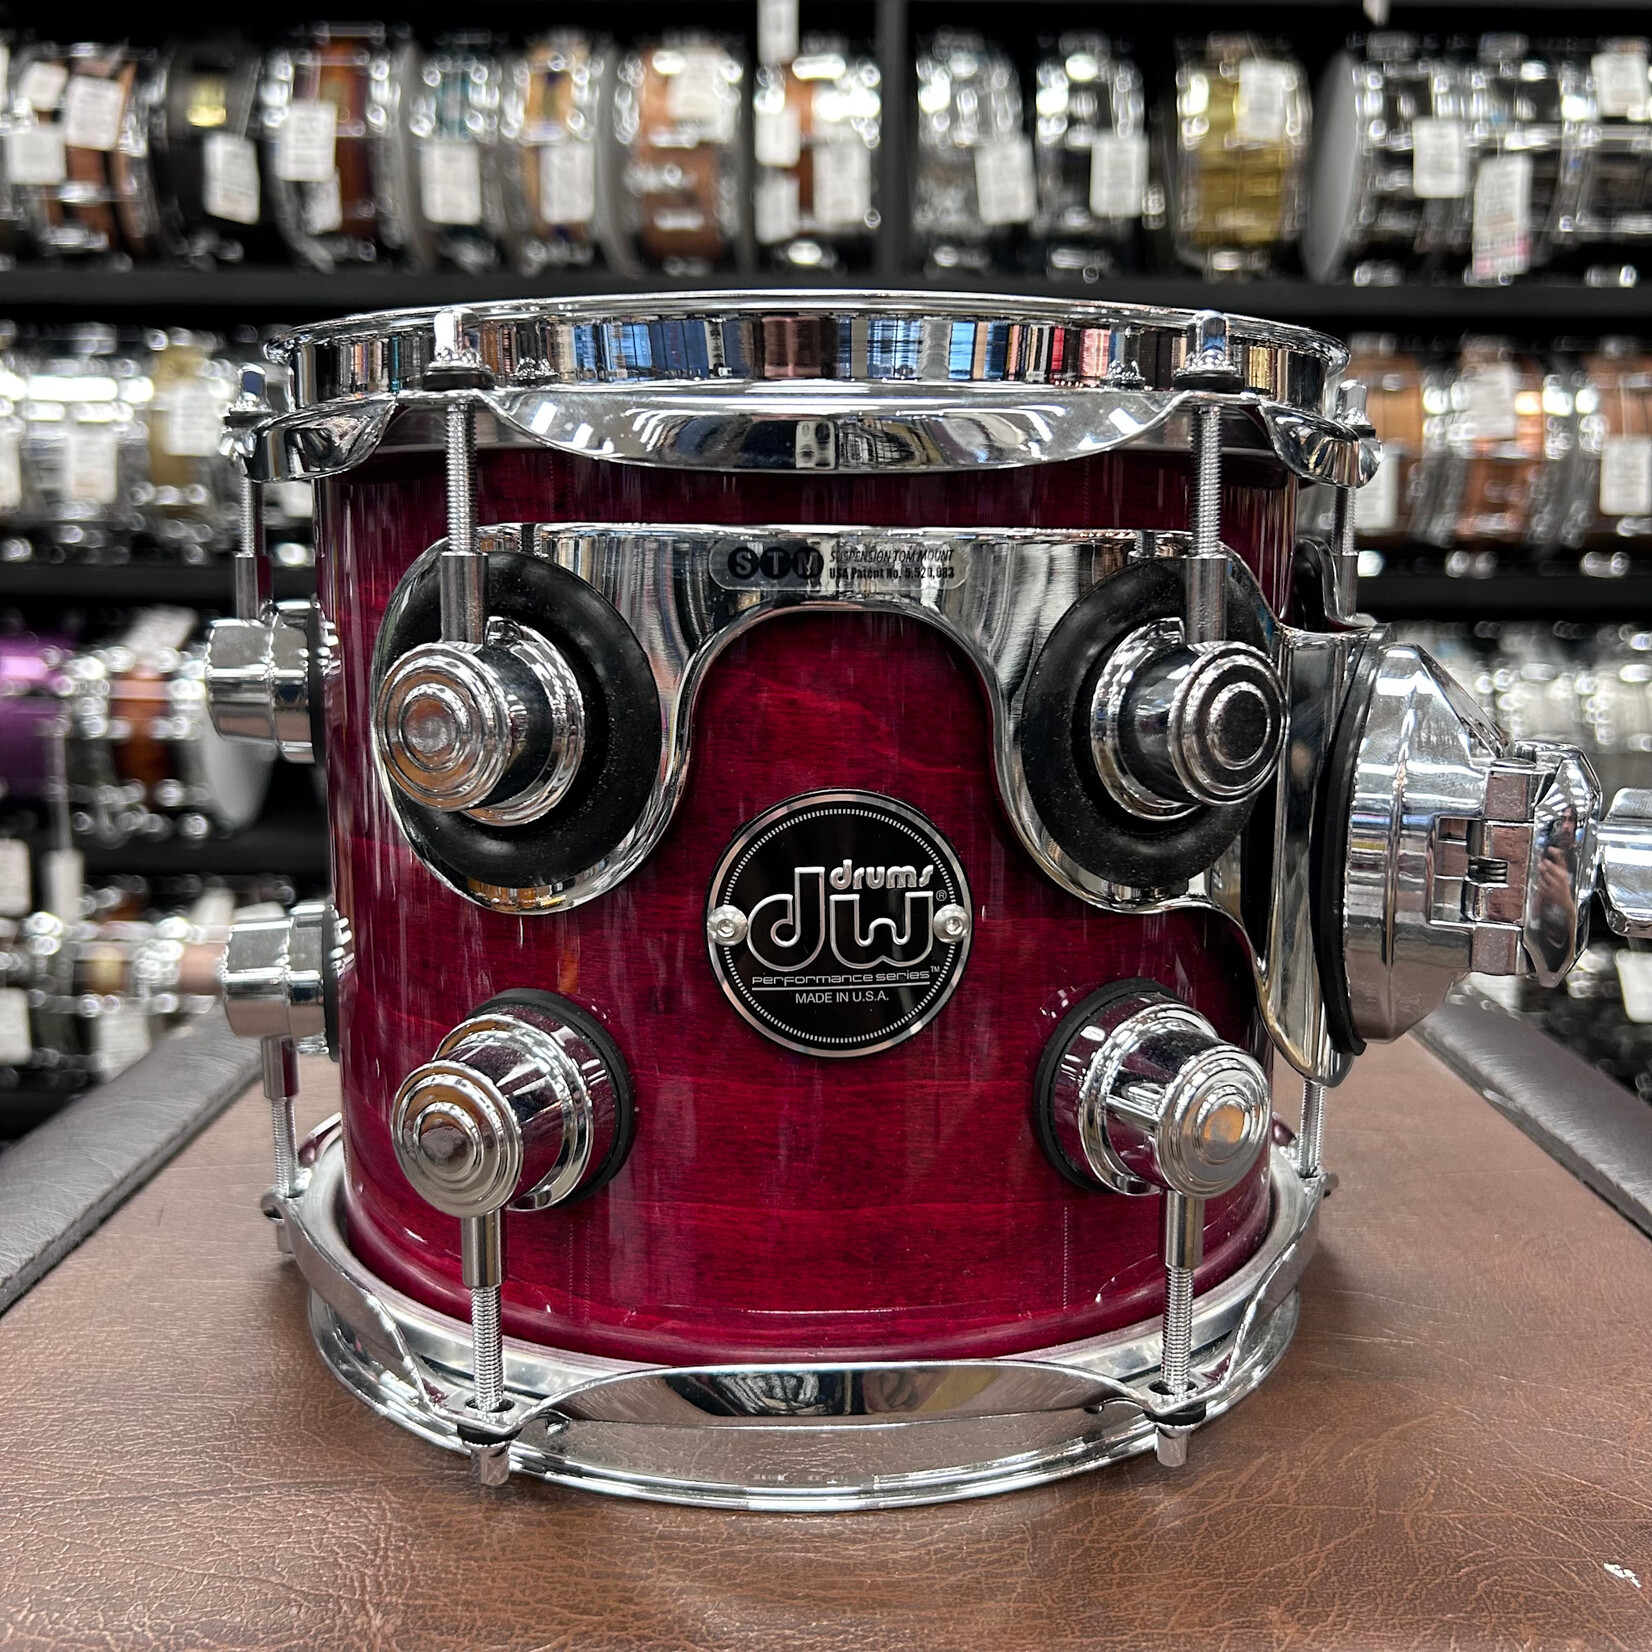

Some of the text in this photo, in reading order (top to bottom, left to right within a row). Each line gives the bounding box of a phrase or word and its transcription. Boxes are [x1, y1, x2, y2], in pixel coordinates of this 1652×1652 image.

[733, 549, 821, 576] STM
[829, 549, 955, 563] SUSPENSION TOM MOUNT
[829, 567, 849, 580] USA
[851, 567, 884, 580] Patent
[886, 567, 902, 580] No.
[829, 858, 934, 889] drums
[795, 990, 889, 1004] MADE IN U.S.A.
